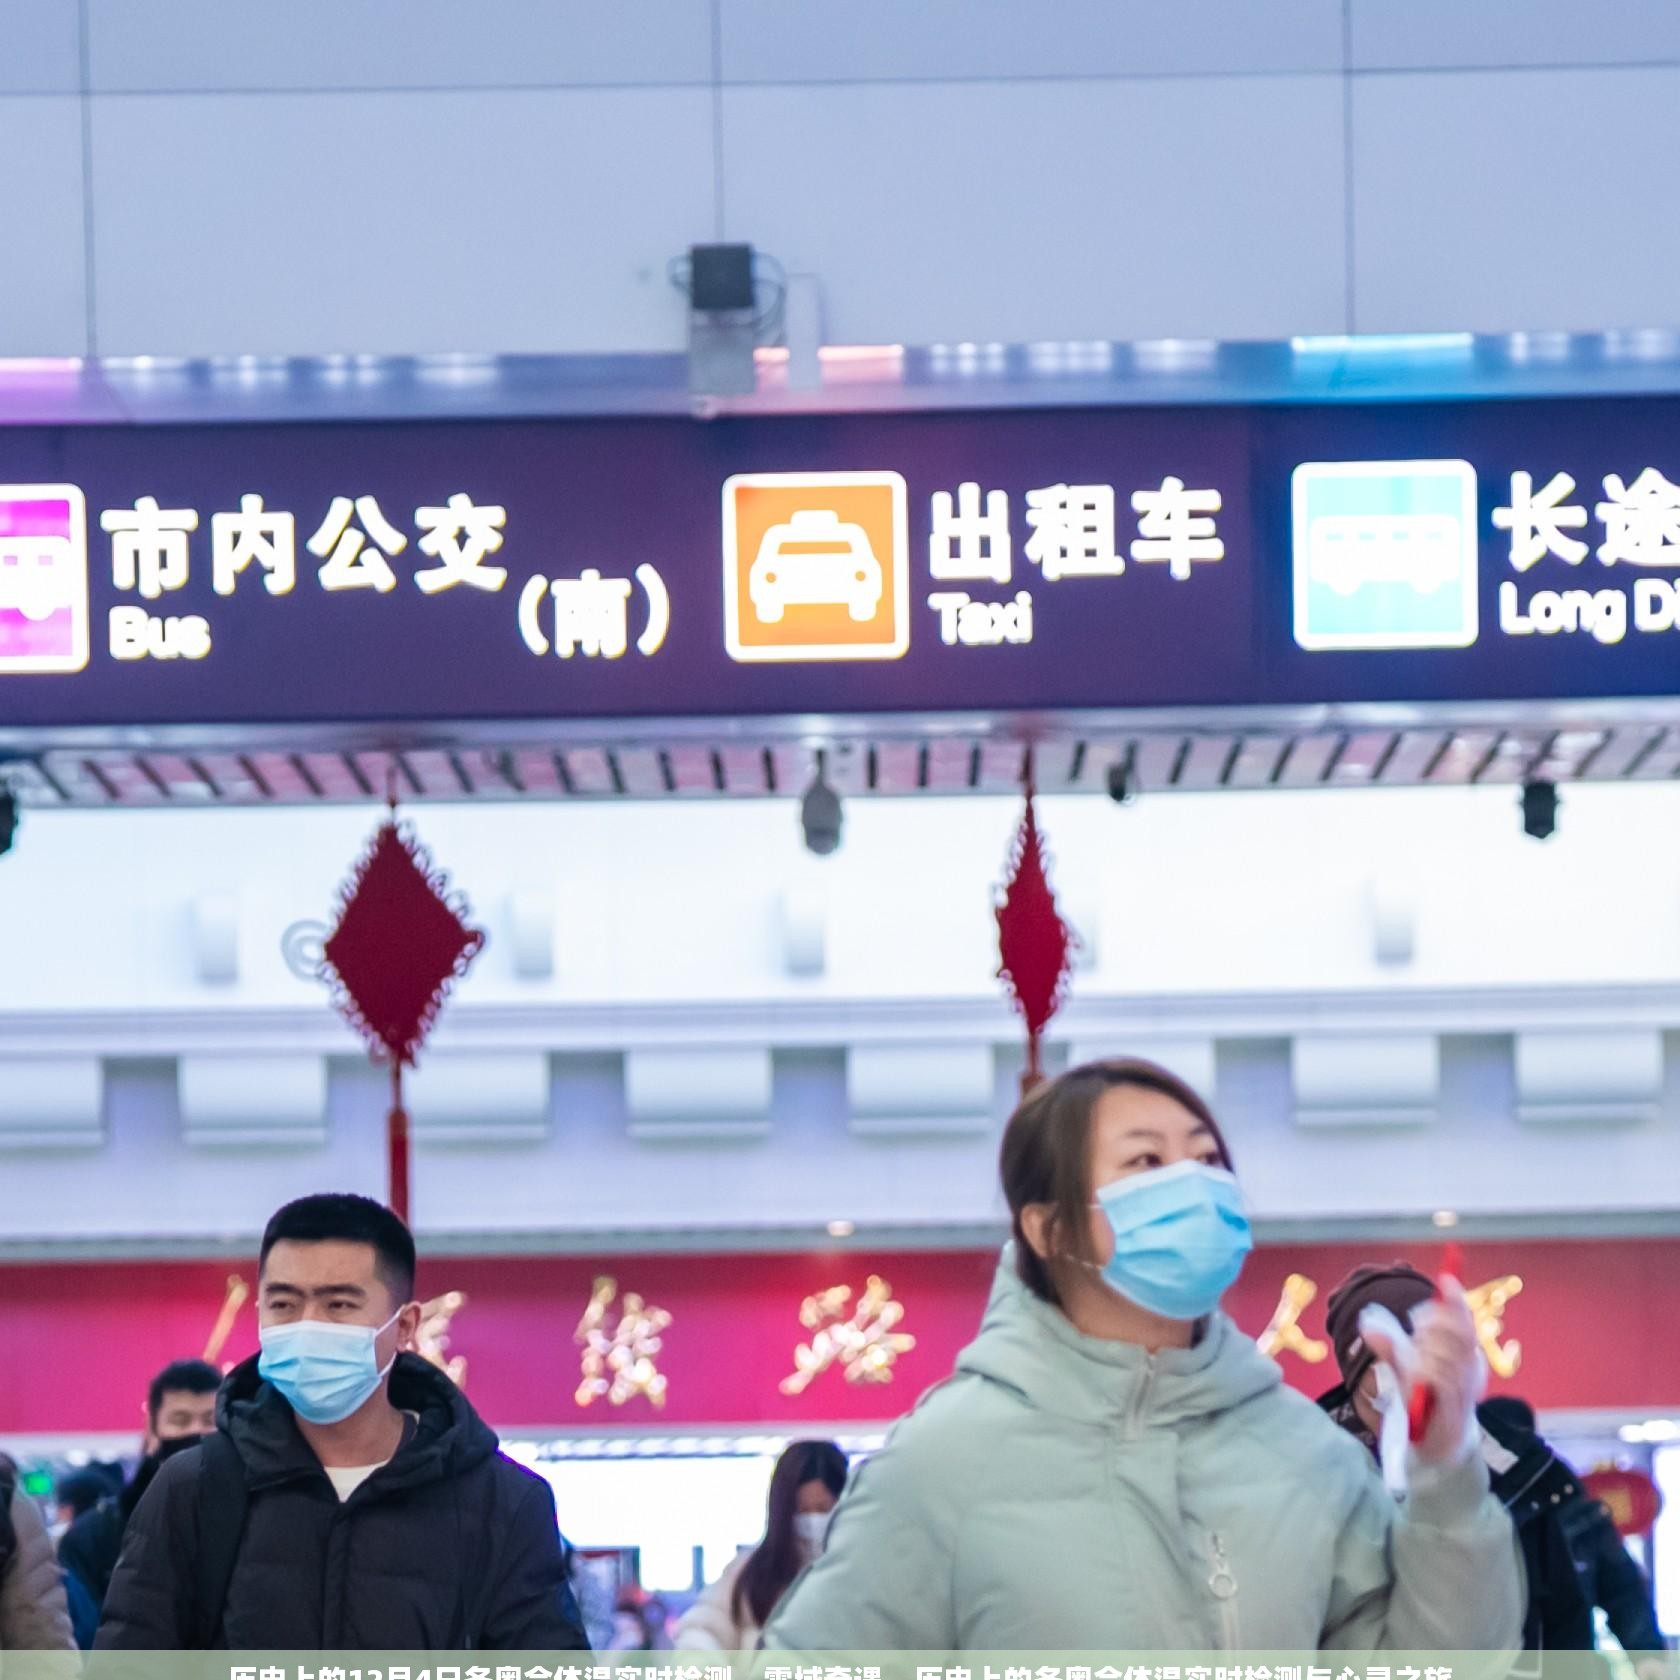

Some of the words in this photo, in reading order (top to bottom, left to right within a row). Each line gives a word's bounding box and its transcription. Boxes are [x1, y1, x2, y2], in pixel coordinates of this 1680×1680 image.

[928, 476, 1225, 583] 出租车
[99, 493, 508, 599] 市内公交
[518, 563, 670, 659] （南）
[108, 605, 212, 660] Bus
[927, 590, 1033, 646] Taxi
[1500, 581, 1627, 644] Long
